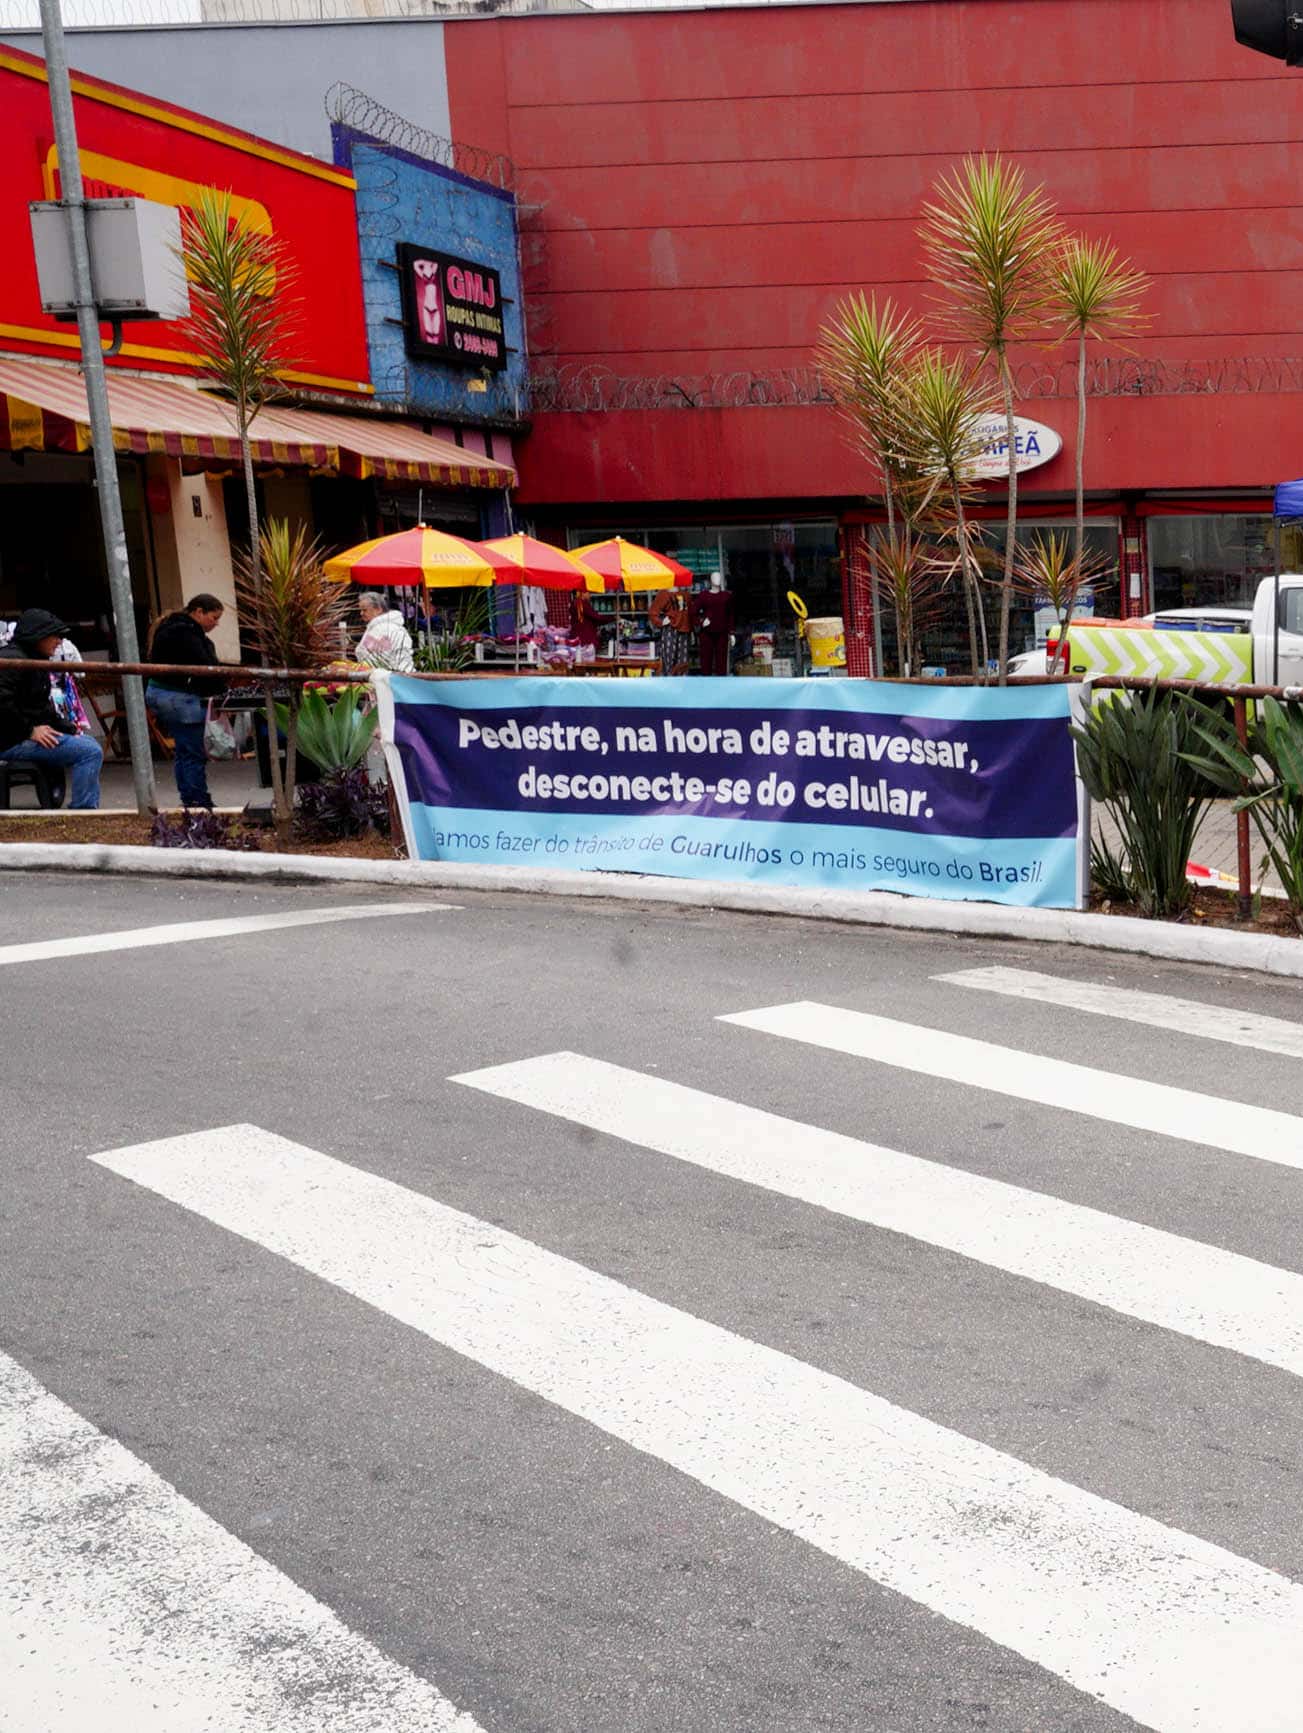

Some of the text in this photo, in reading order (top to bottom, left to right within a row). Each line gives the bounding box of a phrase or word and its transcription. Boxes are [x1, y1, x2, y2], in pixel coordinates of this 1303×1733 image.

[446, 265, 495, 309] GMJ
[459, 718, 979, 774] Pedestre, na hora de atravessar,
[518, 766, 934, 818] desconecte-se do celular.
[496, 831, 542, 853] fazer
[544, 834, 568, 854] do
[574, 832, 635, 854] trânsito
[638, 832, 665, 852] de
[671, 835, 782, 865] Guarulhos
[790, 850, 804, 866] o
[812, 848, 867, 872] mais
[873, 856, 941, 879] seguro
[946, 861, 973, 881] do
